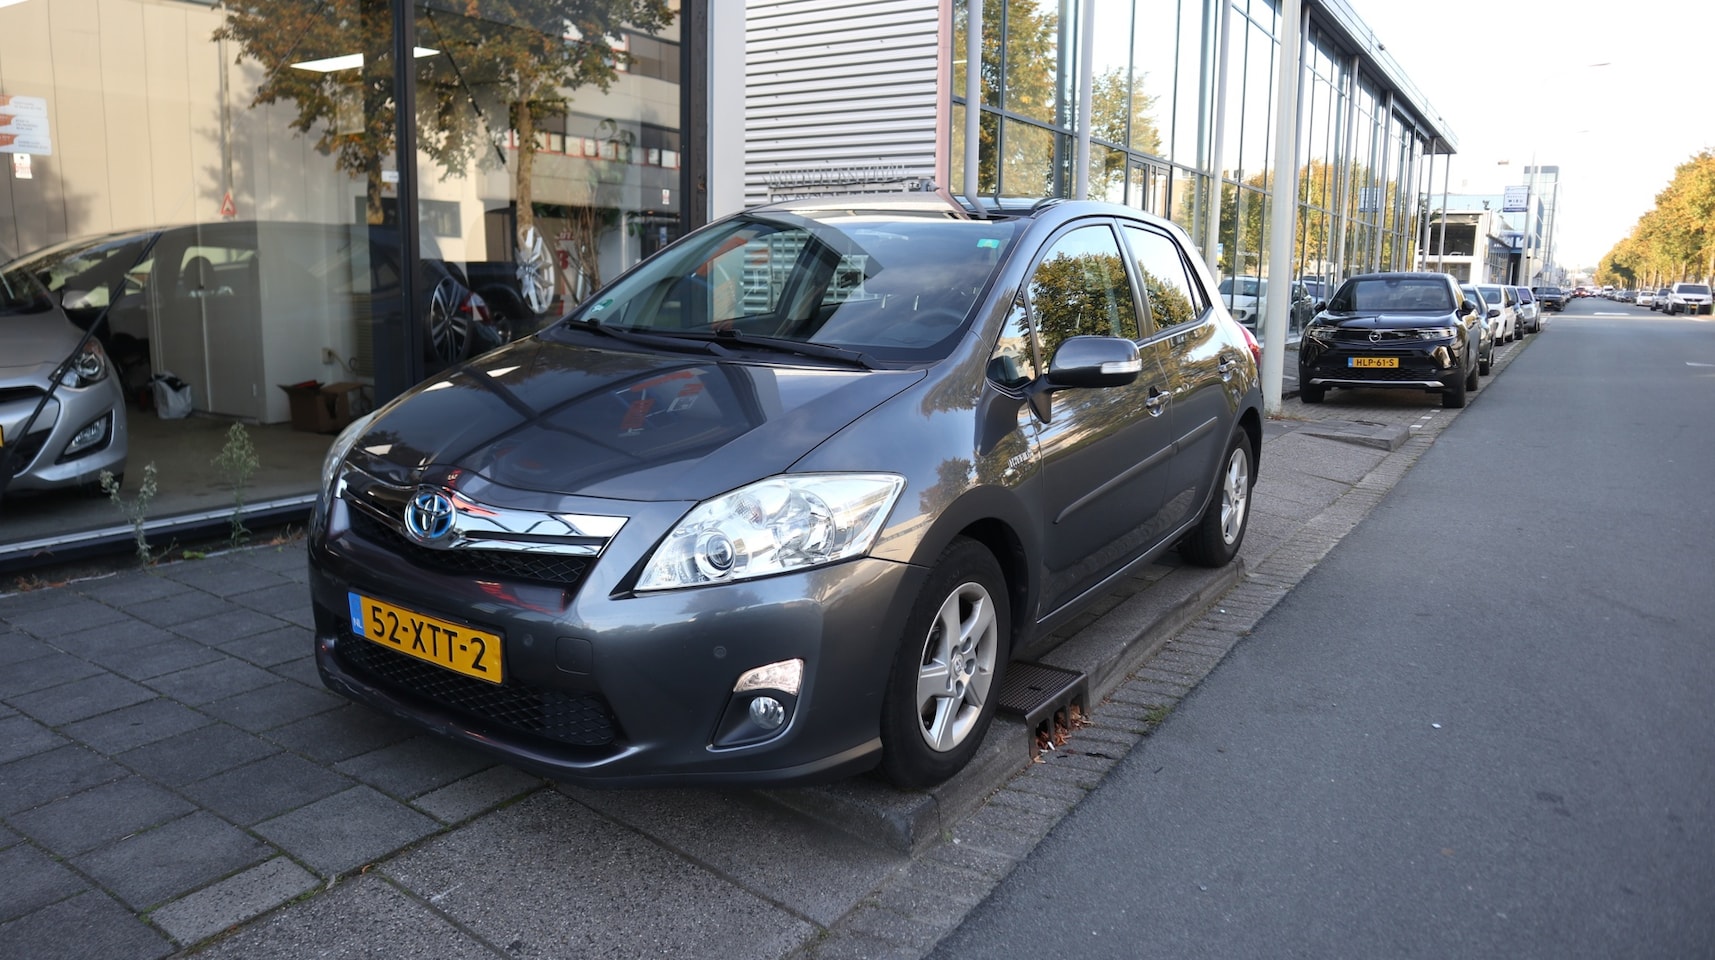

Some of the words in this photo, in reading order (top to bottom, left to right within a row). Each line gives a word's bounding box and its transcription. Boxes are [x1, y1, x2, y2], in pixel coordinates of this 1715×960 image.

[1356, 359, 1394, 367] HLP-61-S
[352, 617, 363, 630] NL
[371, 605, 487, 673] 52-XTT-2
